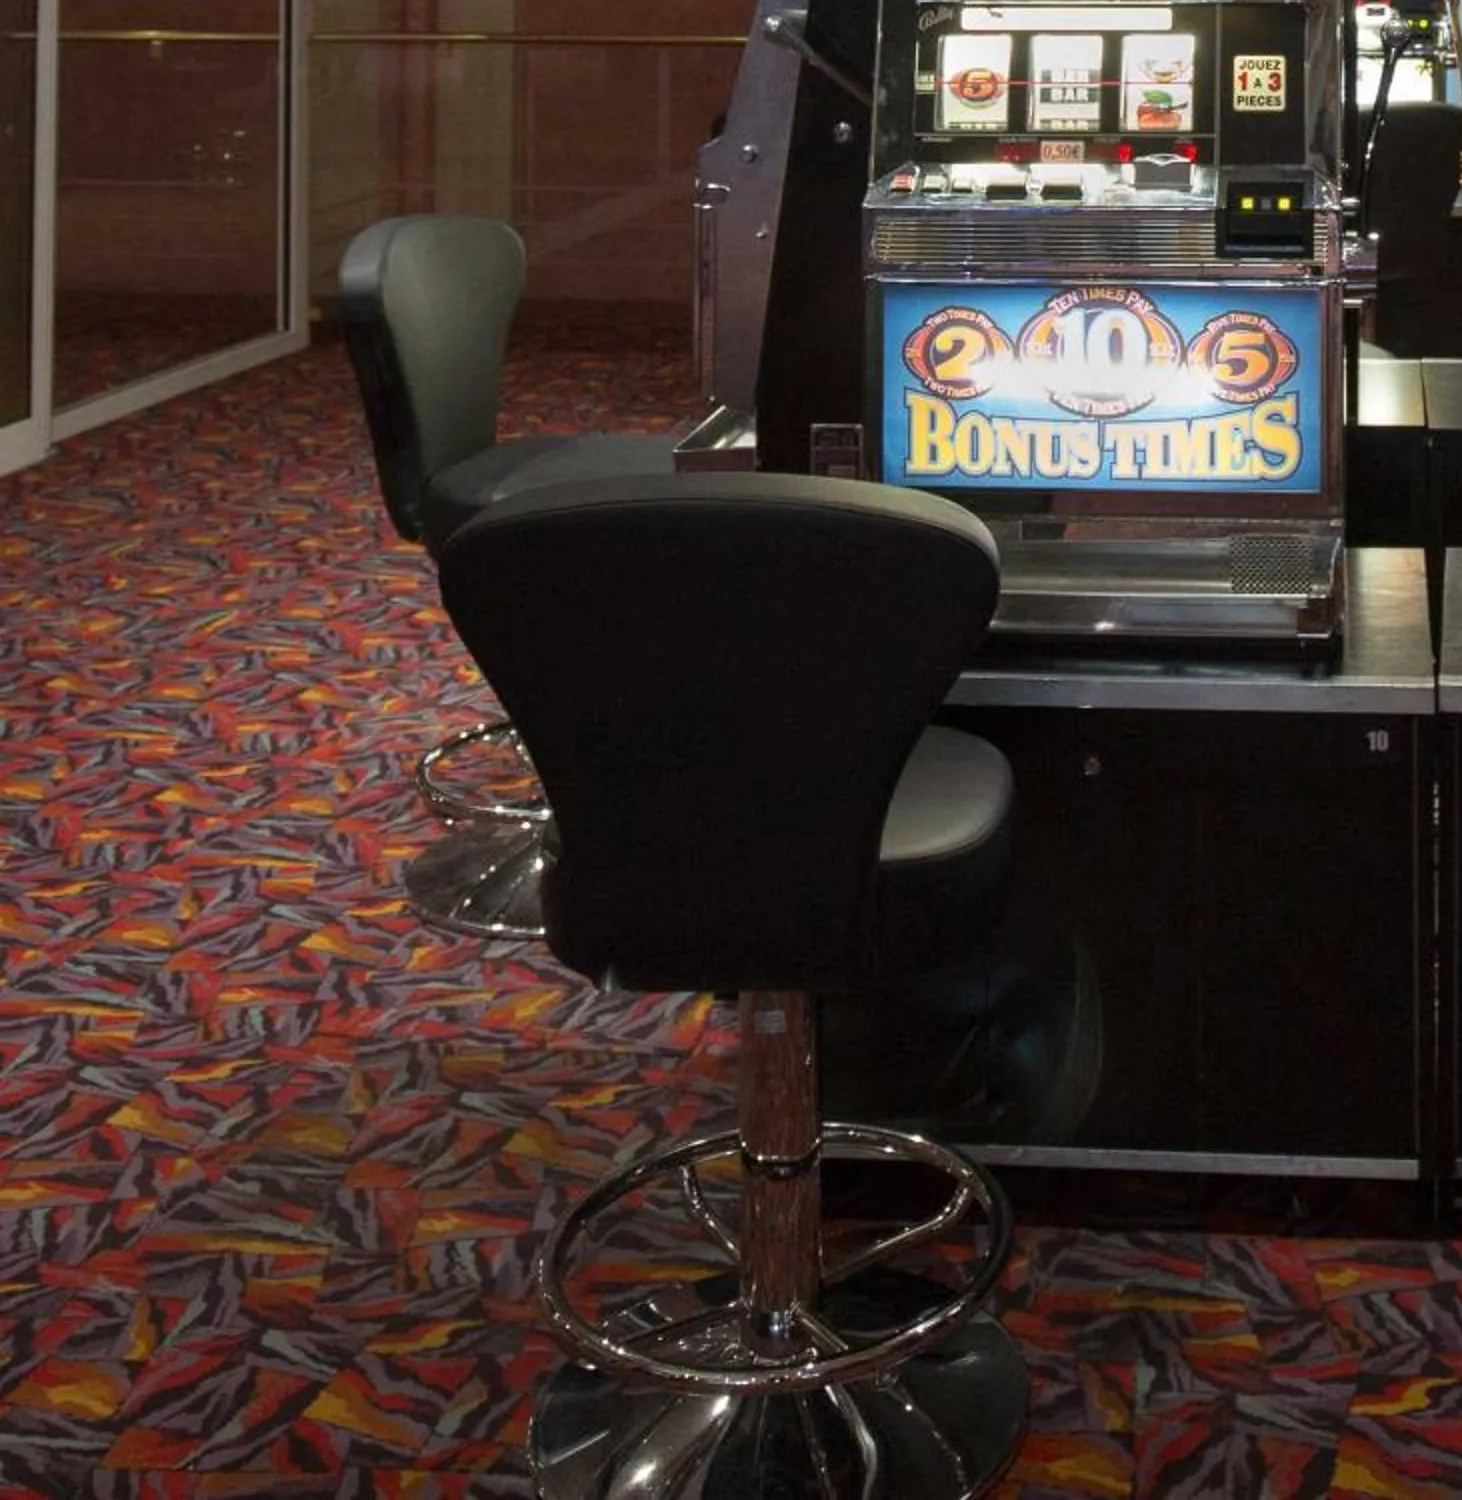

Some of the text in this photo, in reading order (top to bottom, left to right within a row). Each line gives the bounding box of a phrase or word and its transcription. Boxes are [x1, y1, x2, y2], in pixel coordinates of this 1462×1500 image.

[1238, 60, 1281, 71] JOUEZ
[963, 71, 993, 98] 5
[1051, 88, 1089, 102] BAR
[1238, 72, 1282, 93] 1 A 3
[1237, 95, 1282, 107] PIECES
[1048, 287, 1153, 315] TEN TIMES PAY
[934, 325, 988, 381] 2
[1052, 308, 1148, 380] 10
[1215, 331, 1270, 386] 5
[906, 391, 1300, 479] BONUS TIMES
[1365, 730, 1389, 752] 10
